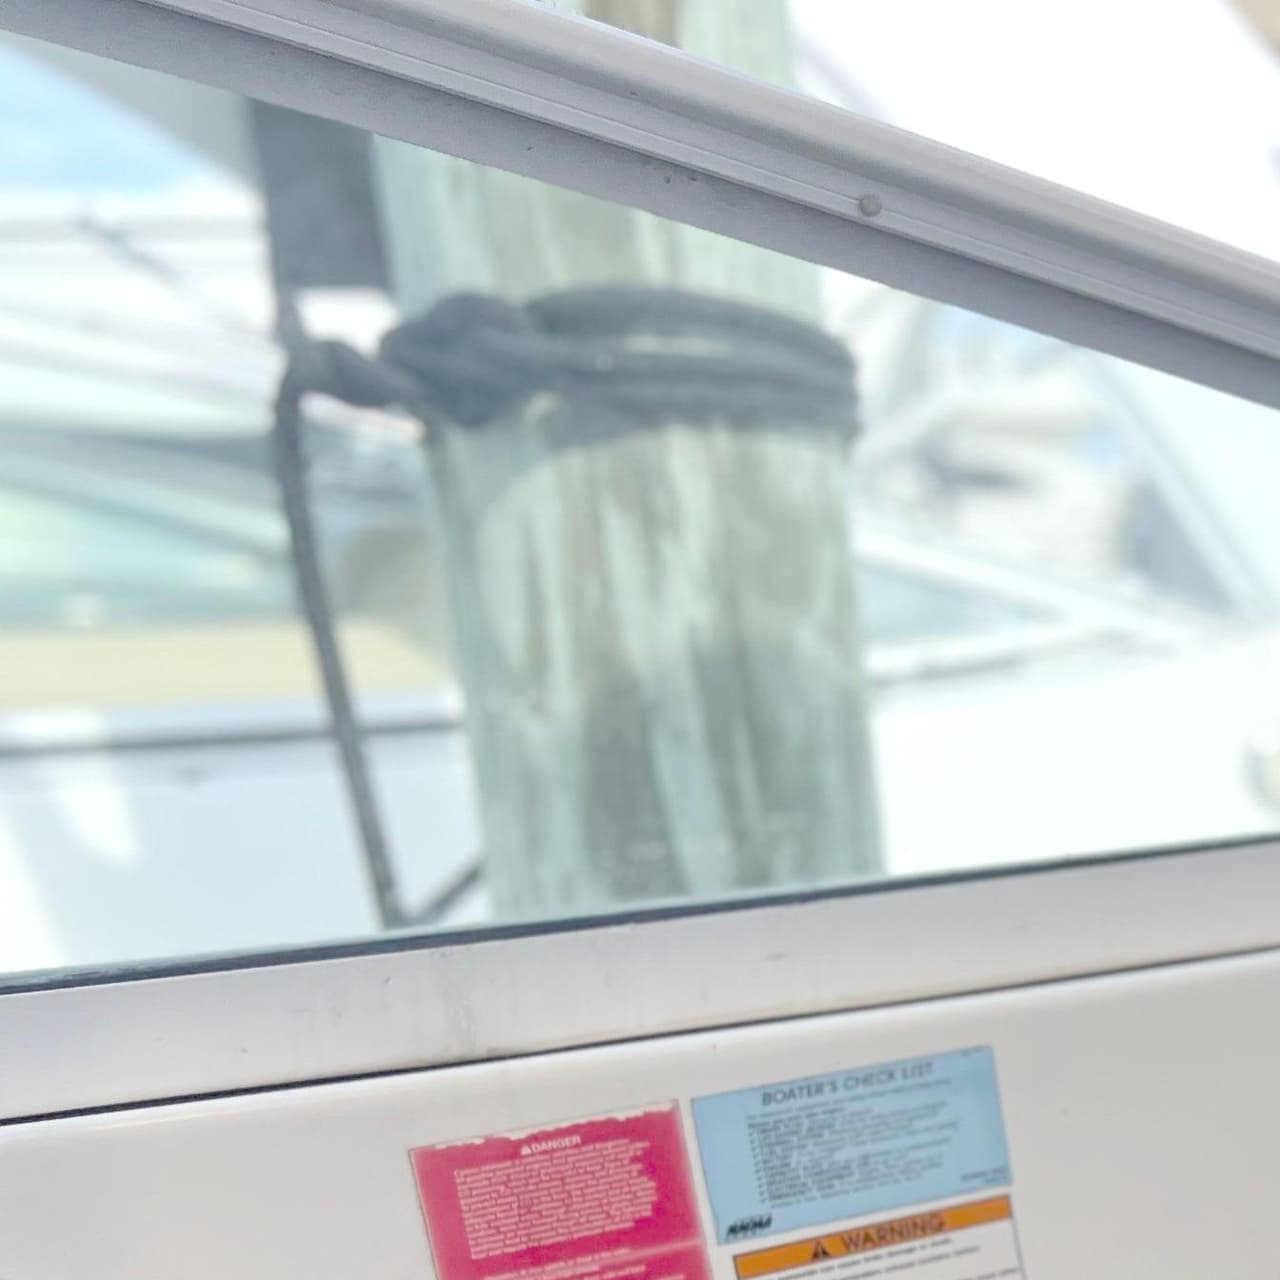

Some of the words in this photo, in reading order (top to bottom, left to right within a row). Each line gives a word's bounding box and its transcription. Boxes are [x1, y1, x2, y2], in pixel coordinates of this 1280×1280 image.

[761, 1080, 839, 1106] BOATER'S
[844, 1070, 897, 1092] CHECK
[901, 1061, 934, 1081] LIST
[531, 1135, 582, 1154] DANGER
[840, 1213, 946, 1250] WARNING
